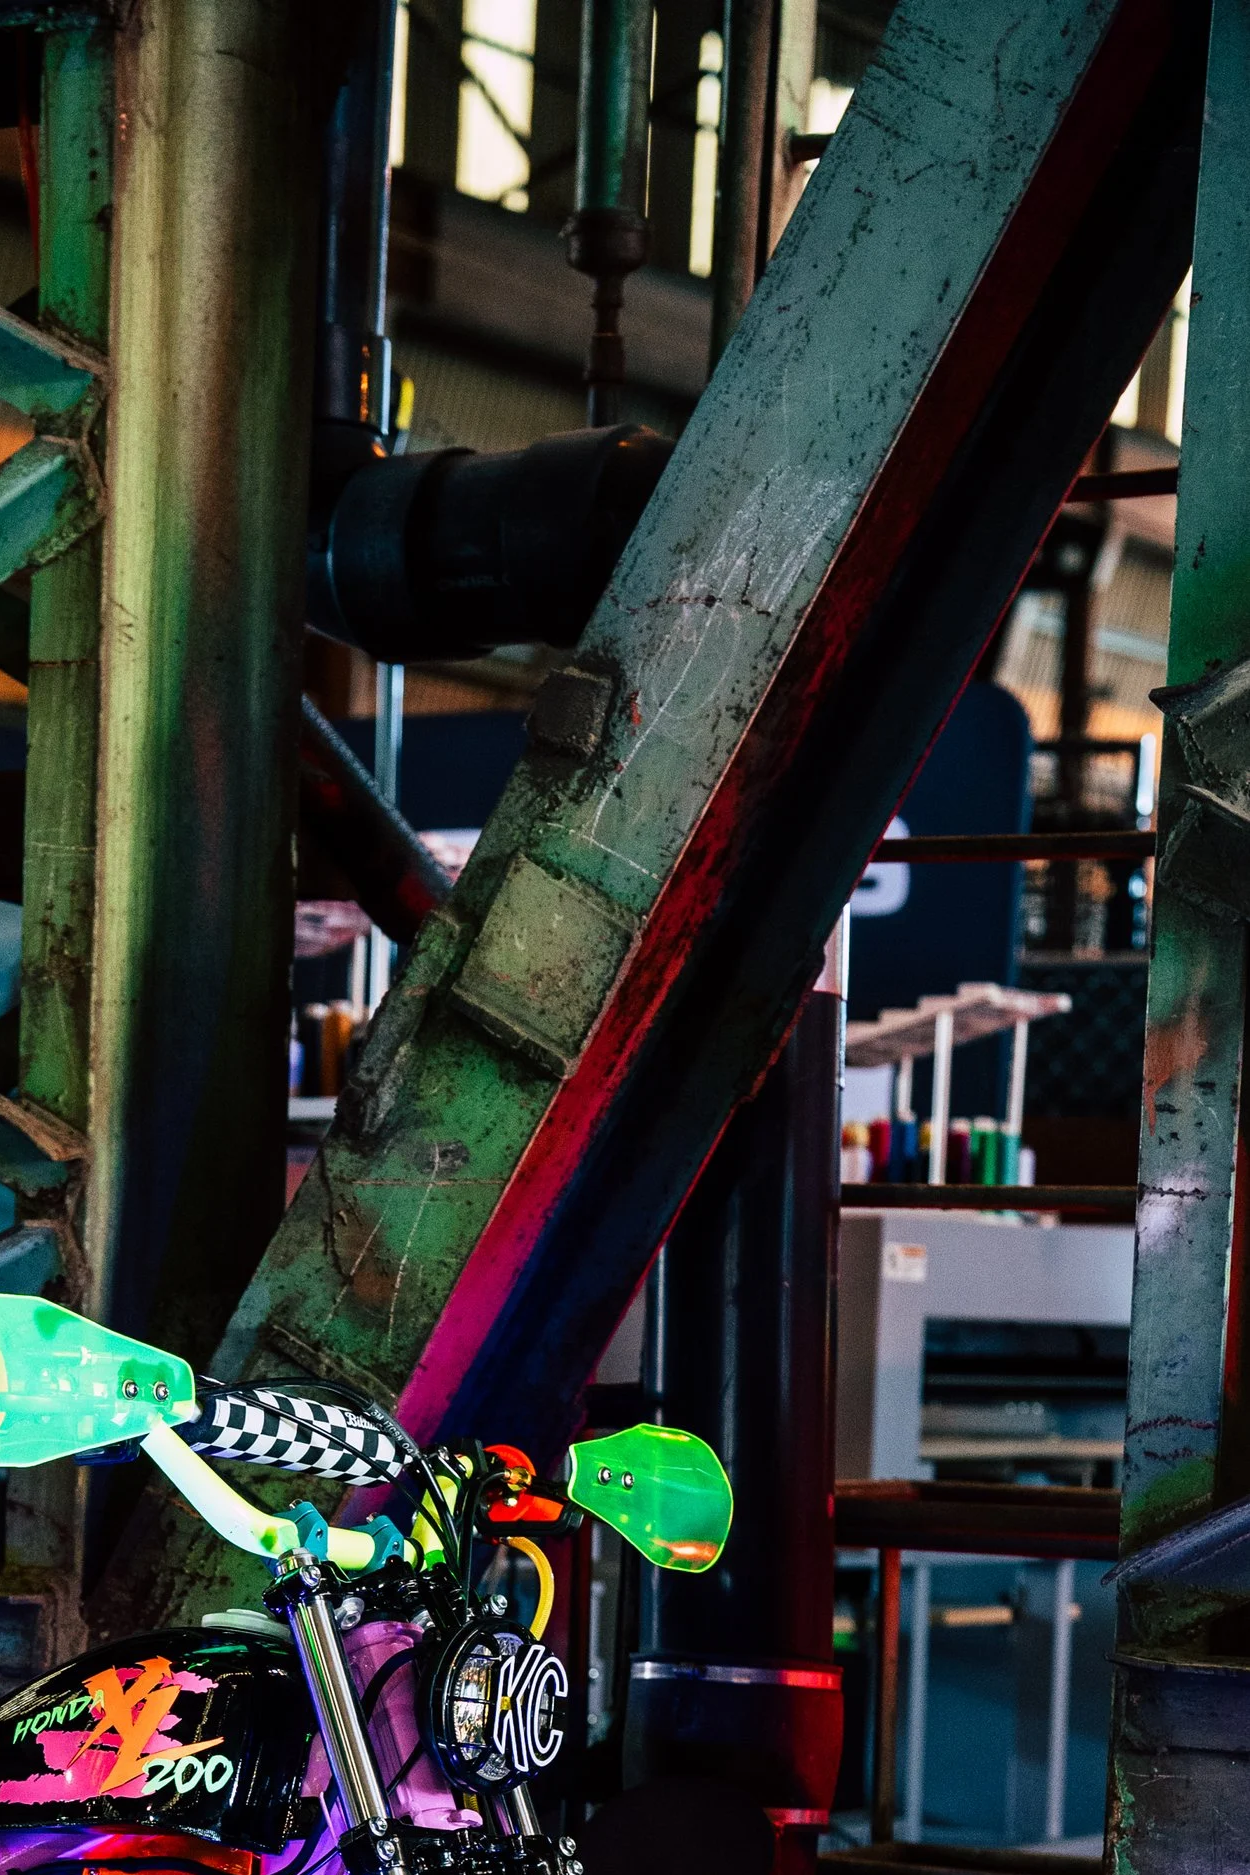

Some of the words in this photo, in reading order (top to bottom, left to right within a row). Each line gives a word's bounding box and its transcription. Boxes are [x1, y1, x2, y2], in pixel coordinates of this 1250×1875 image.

[13, 1689, 105, 1744] HONDA
[67, 1655, 224, 1793] XL
[492, 1644, 568, 1771] KC
[141, 1754, 234, 1794] 200
